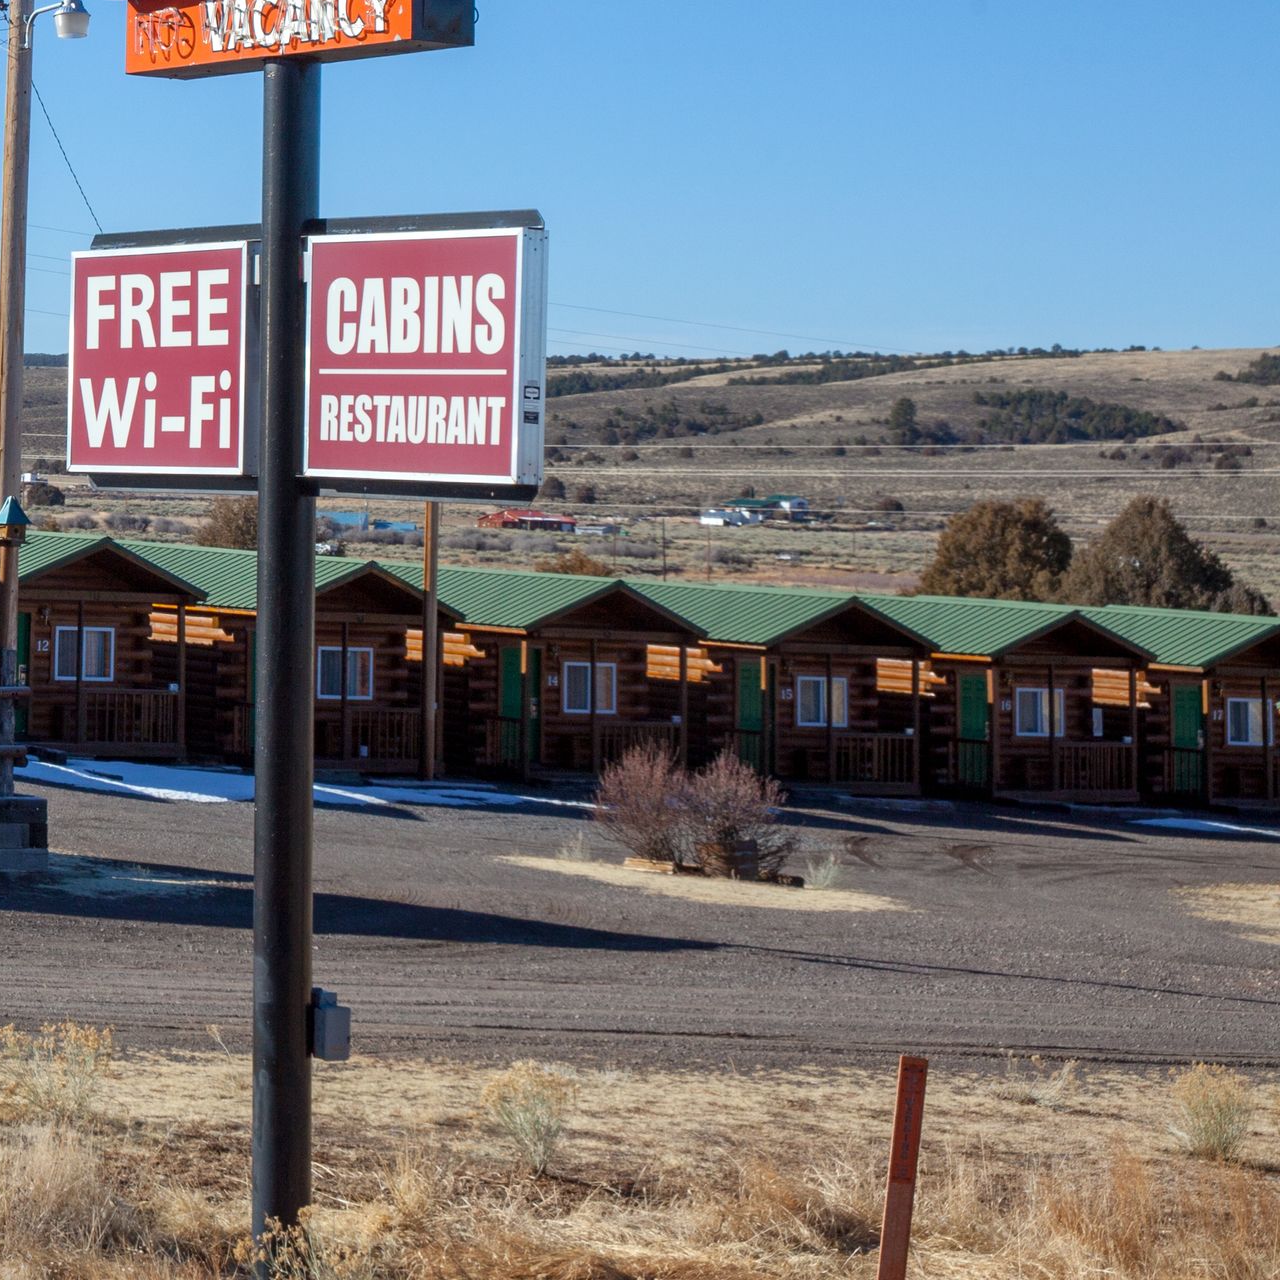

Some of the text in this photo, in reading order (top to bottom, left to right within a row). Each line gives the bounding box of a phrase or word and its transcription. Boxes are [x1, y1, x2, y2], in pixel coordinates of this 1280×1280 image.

[134, 7, 181, 57] NO
[86, 268, 230, 350] FREE
[325, 272, 507, 356] CABINS
[79, 370, 233, 450] Wi-Fi
[320, 394, 507, 445] RESTAURANT
[36, 639, 50, 652] 12
[781, 688, 793, 700] 15
[1001, 699, 1012, 711] 16
[1212, 709, 1223, 721] 17
